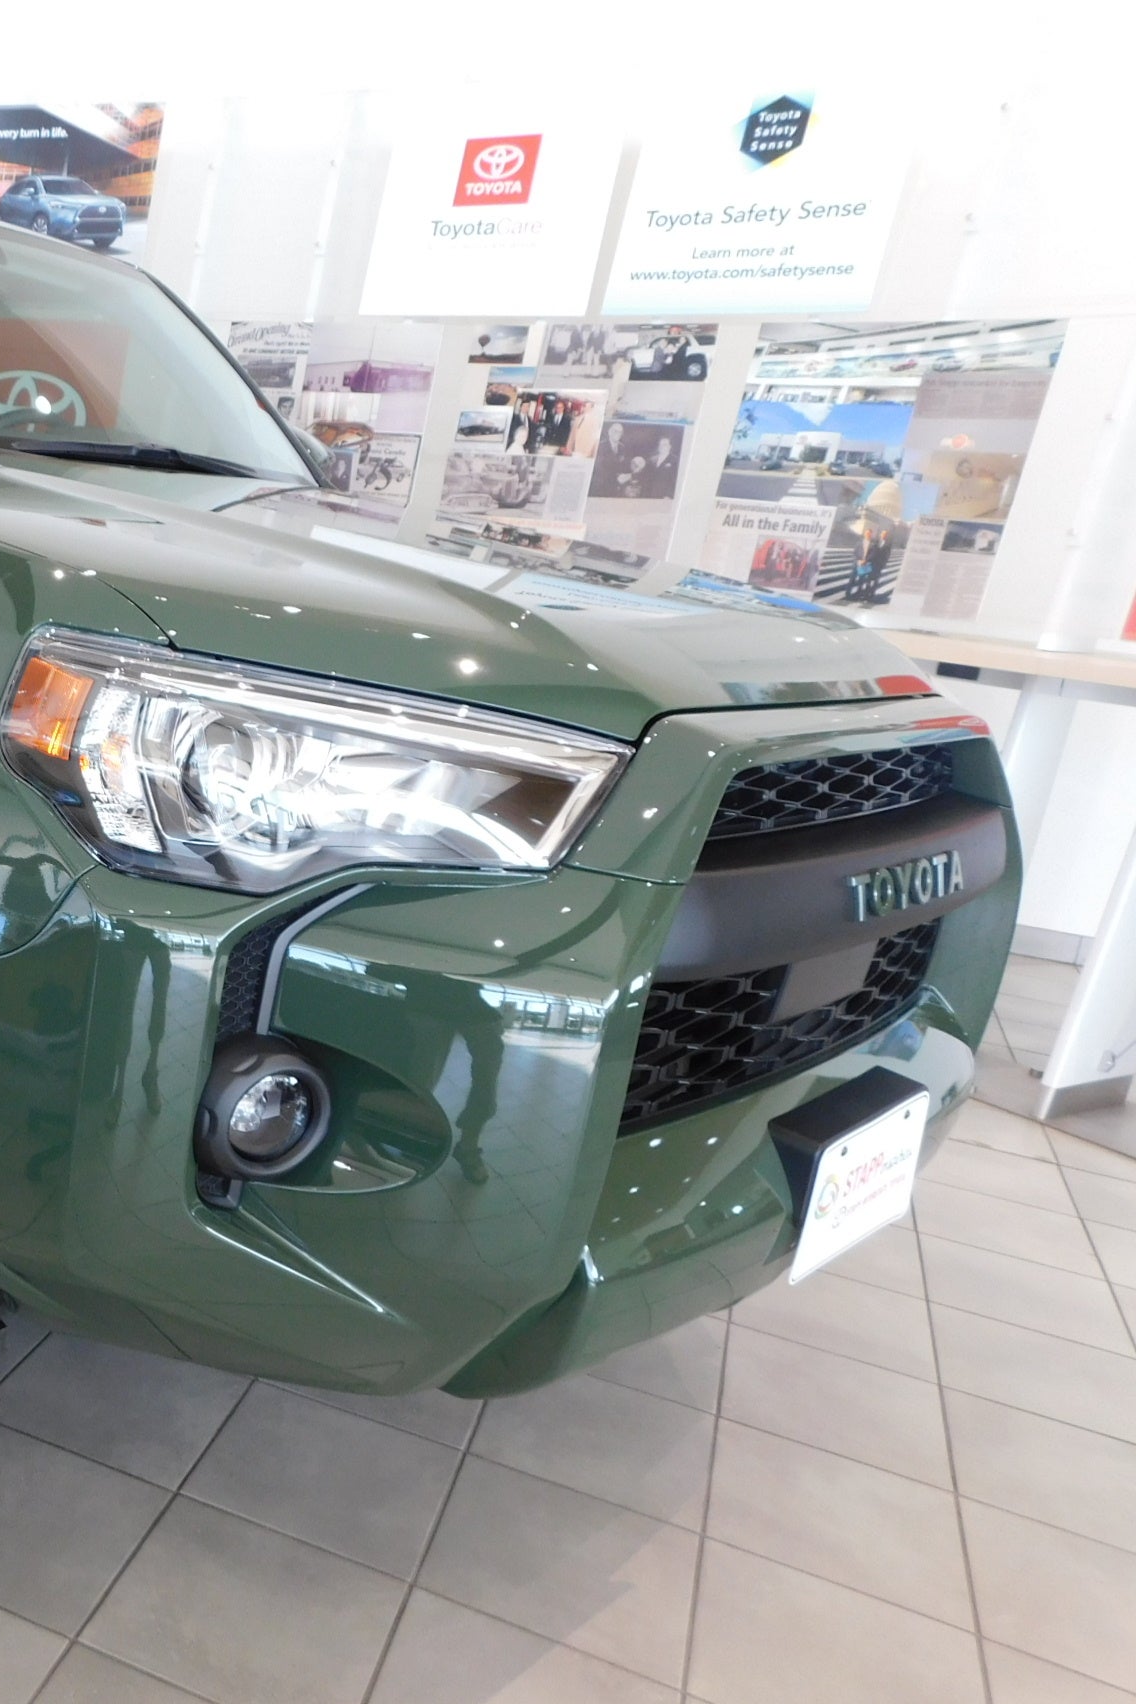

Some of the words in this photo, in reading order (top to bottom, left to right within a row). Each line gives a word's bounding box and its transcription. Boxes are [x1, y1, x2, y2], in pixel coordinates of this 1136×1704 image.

[759, 110, 802, 124] Toyota
[20, 128, 40, 138] turn
[40, 127, 50, 138] in
[51, 126, 69, 138] life.
[754, 125, 798, 138] Safety
[750, 140, 794, 152] Sense
[465, 180, 522, 197] TOYOTA
[647, 210, 714, 232] Toyota
[721, 203, 792, 227] Safety
[798, 200, 868, 220] Sense
[431, 217, 543, 241] ToyotaCare
[692, 247, 732, 260] Learn
[736, 248, 776, 259] more
[779, 245, 795, 257] at
[630, 262, 855, 284] www.toyota.com/safetysense
[722, 513, 741, 529] All
[741, 516, 755, 529] in
[758, 517, 781, 532] the
[782, 518, 828, 538] Family
[847, 850, 964, 922] TOYOTA
